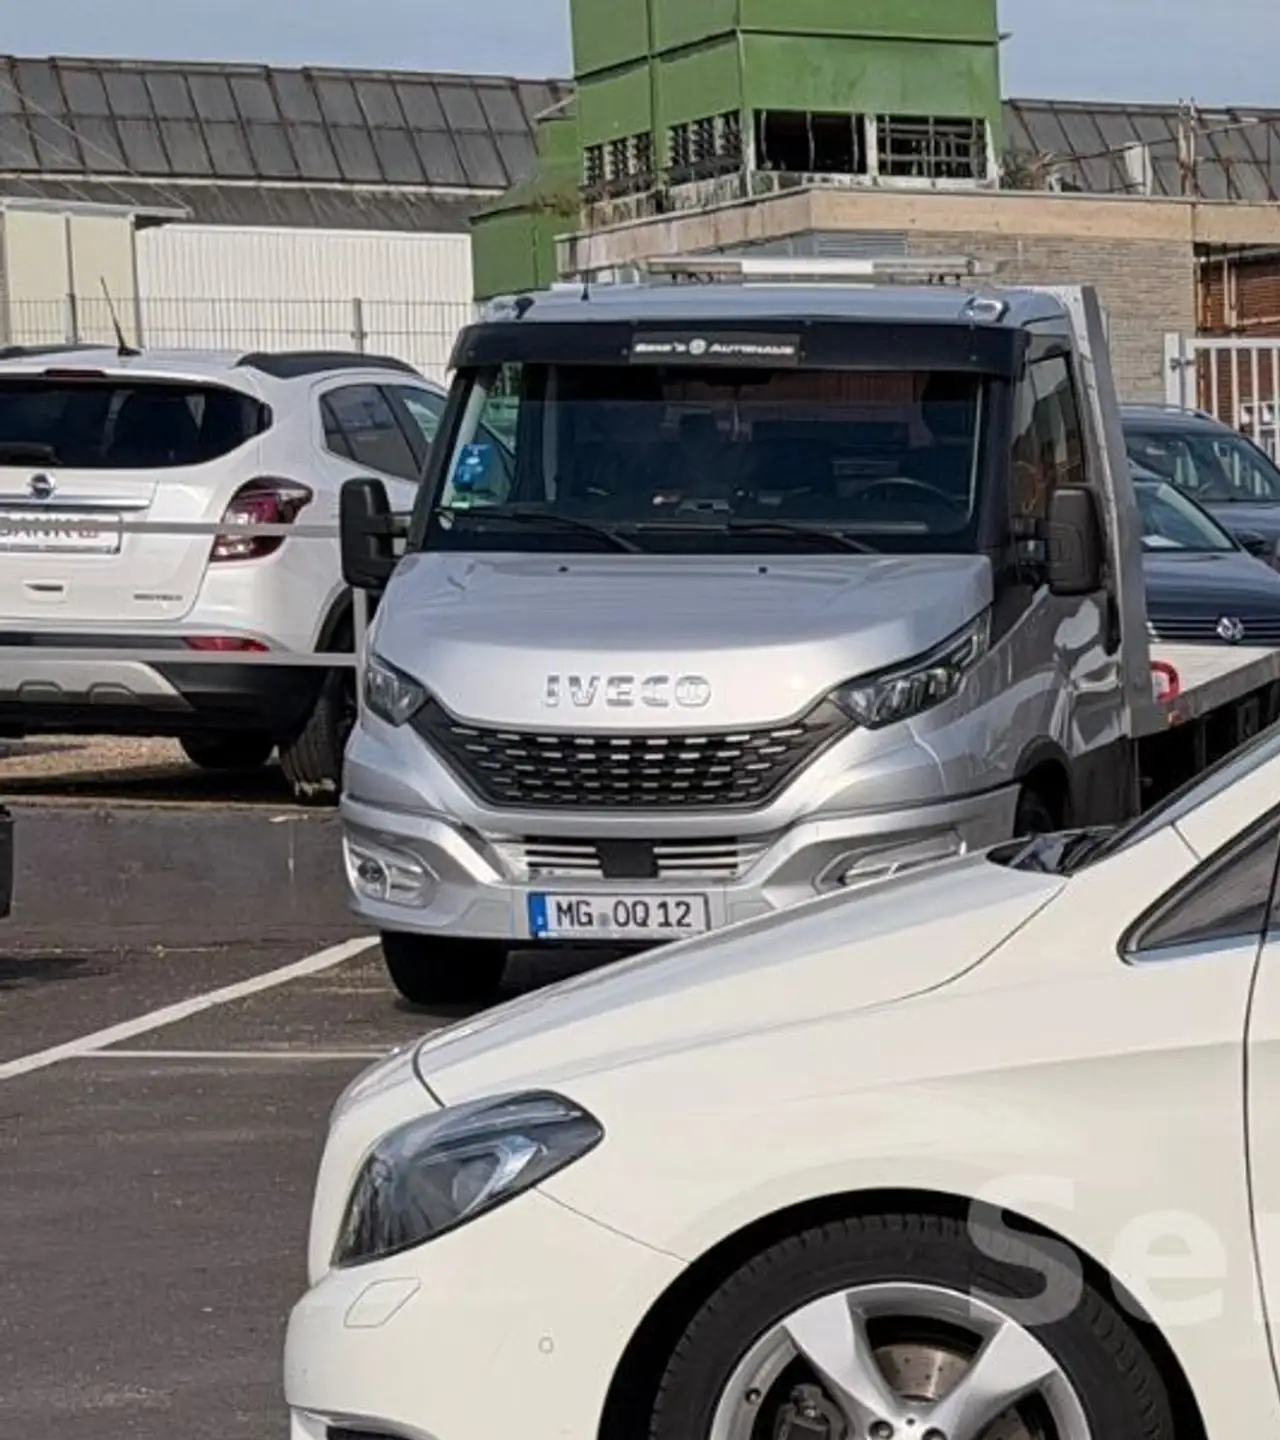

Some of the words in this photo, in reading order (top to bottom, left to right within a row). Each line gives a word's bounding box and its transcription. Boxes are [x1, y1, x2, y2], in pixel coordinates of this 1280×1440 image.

[545, 674, 712, 708] IVECO
[555, 900, 594, 928] MG
[612, 900, 650, 928] OQ
[657, 900, 693, 928] 12
